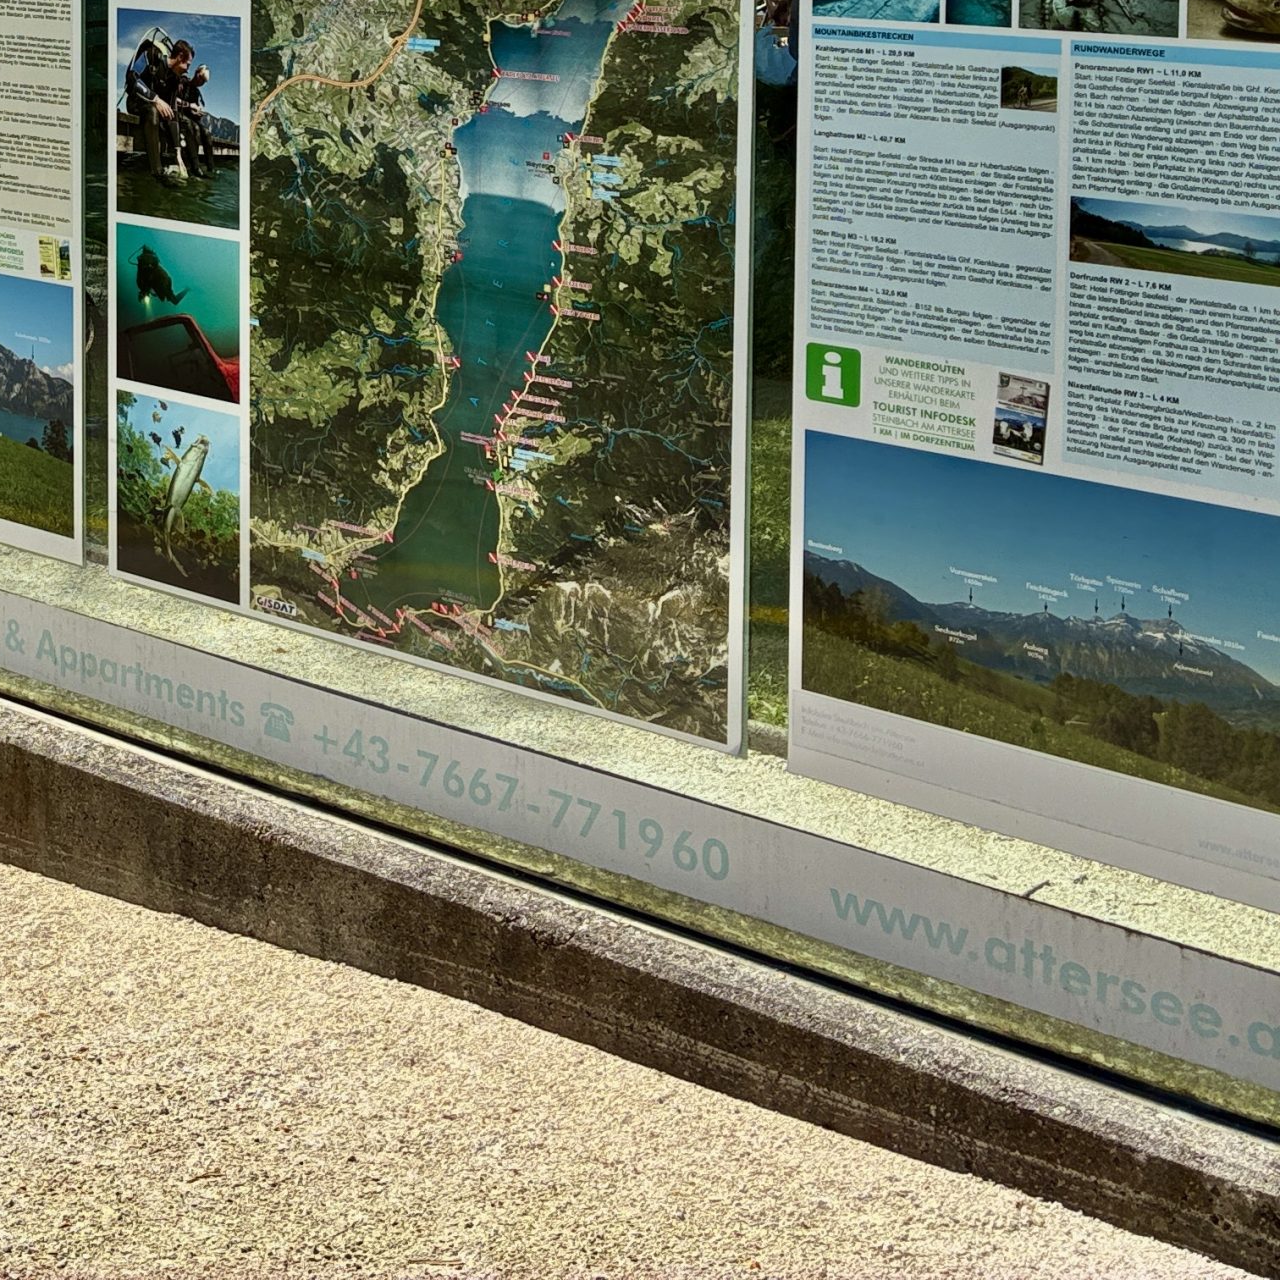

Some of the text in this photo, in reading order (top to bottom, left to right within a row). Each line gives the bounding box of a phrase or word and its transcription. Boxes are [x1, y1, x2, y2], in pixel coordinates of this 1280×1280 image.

[814, 28, 914, 40] MOUNTAINBIKESTRECKEN
[1073, 44, 1166, 57] RUNDWANDERWEGE
[1074, 62, 1135, 73] Panoramarunde
[1069, 271, 1107, 283] Dorfrunde
[885, 355, 965, 375] WANDERROUTEN
[879, 366, 898, 376] UND
[901, 369, 935, 382] WEITERE
[938, 375, 959, 387] TIPPS
[874, 376, 975, 400] UNSERER WANDERKARTE
[939, 399, 960, 409] BEIM
[873, 401, 976, 427] TOURIST INFODESK
[872, 413, 919, 428] STEINBACH
[936, 425, 975, 438] ATTERSEE
[912, 434, 975, 451] DORFZENTRUM
[256, 596, 295, 614] GISDAT
[4, 623, 26, 655] &
[35, 629, 246, 729] Appartments
[313, 724, 730, 881] +43-7667-771960
[829, 886, 1280, 1060] www.attersee.a
